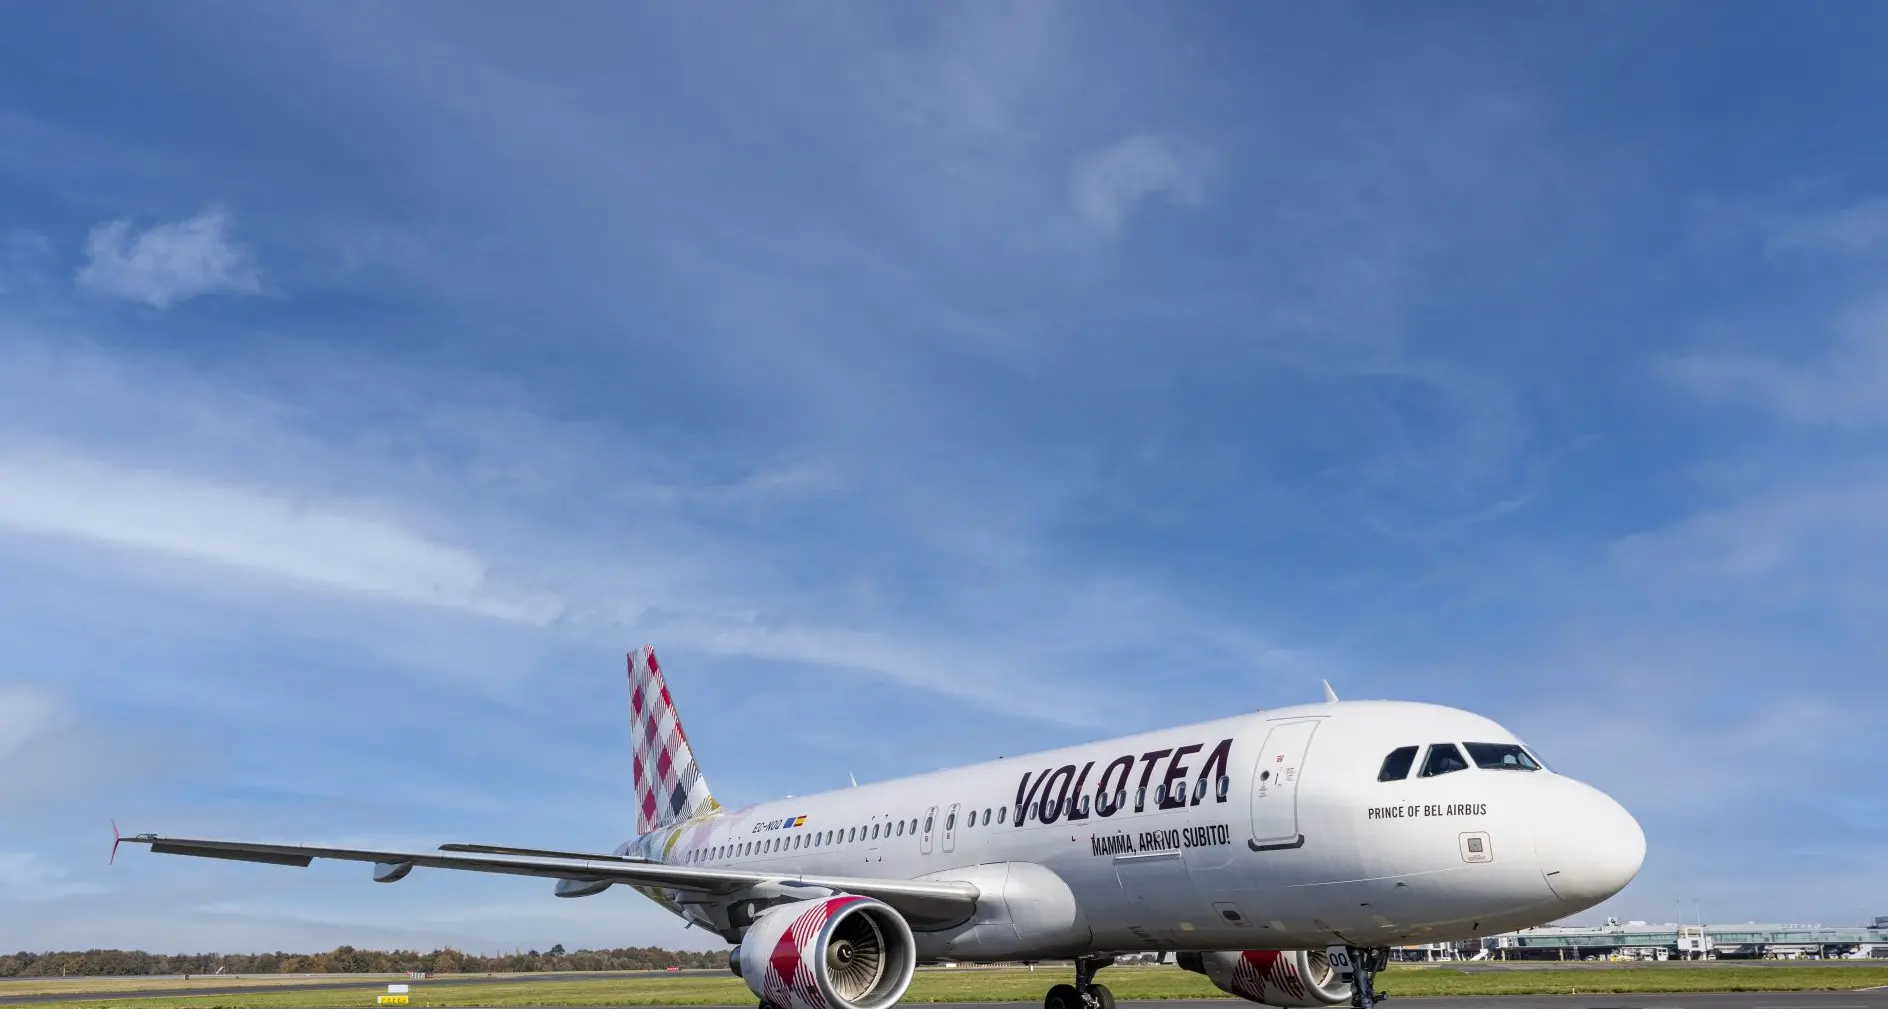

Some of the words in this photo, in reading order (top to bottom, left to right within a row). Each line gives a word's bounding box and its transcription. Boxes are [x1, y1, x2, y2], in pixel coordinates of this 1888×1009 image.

[1014, 738, 1234, 827] VOLOTEA
[1368, 806, 1404, 819] PRINCE
[1407, 805, 1420, 817] OF
[1424, 804, 1443, 817] BEL
[1446, 803, 1487, 816] AIRBUS
[1091, 834, 1137, 857] MAMMA,
[1139, 829, 1180, 851] ARRIVO
[1182, 824, 1230, 848] SUBITO!
[1329, 952, 1348, 967] OQ
